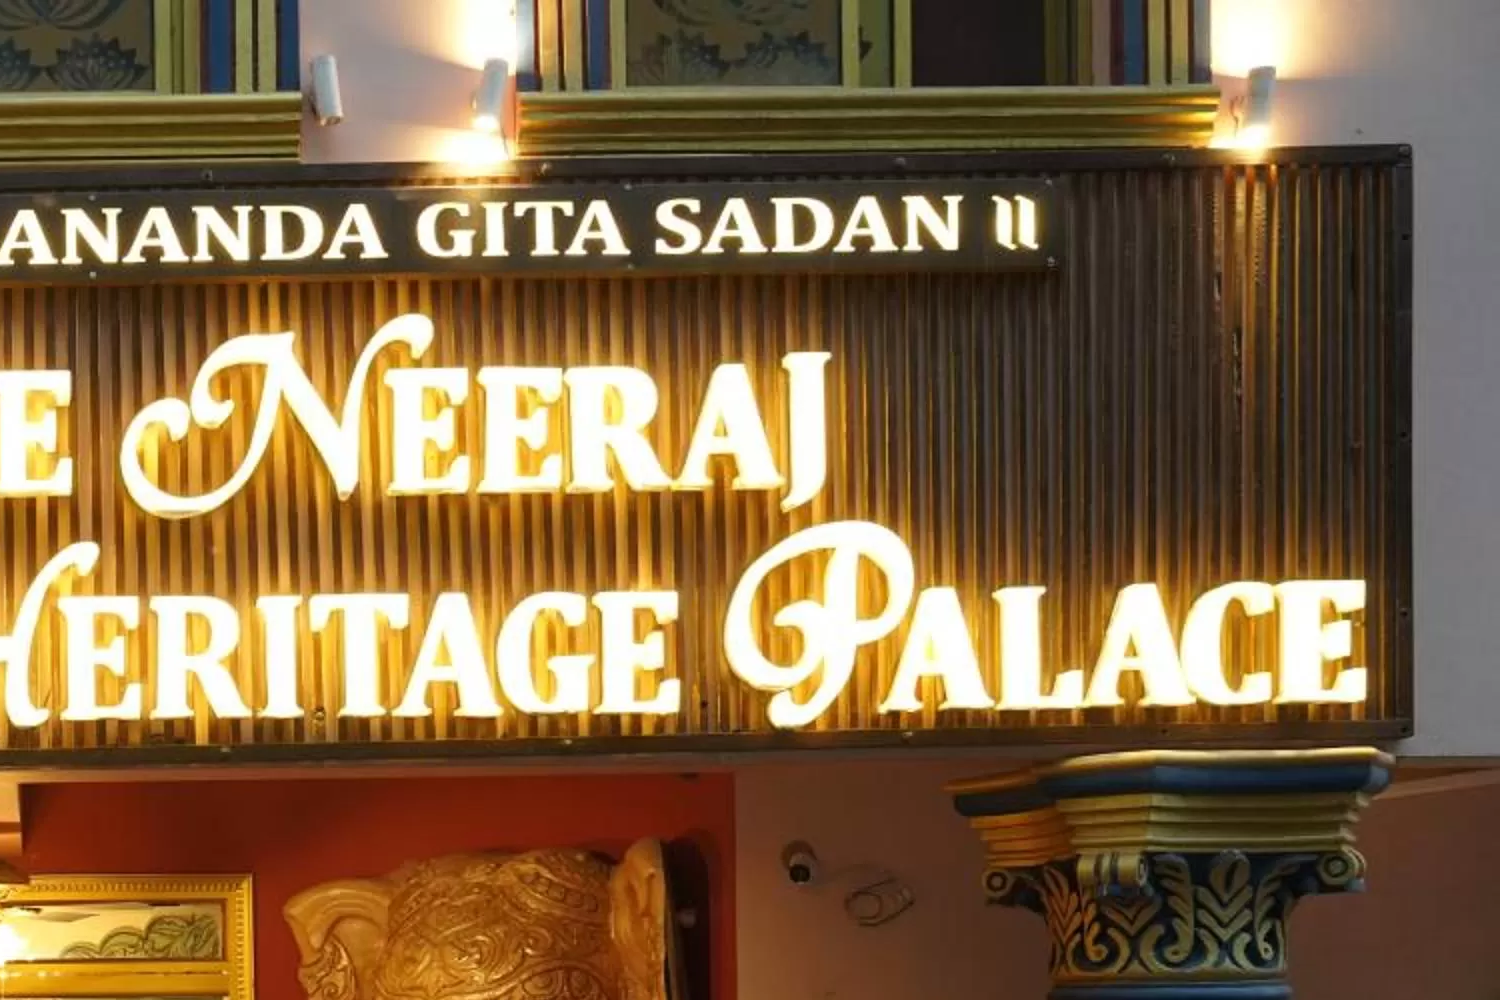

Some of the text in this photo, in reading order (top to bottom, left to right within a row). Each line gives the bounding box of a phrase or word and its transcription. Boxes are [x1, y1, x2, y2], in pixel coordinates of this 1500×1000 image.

[416, 200, 630, 259] GITA
[654, 194, 963, 256] SADAN
[121, 313, 833, 519] NEERAJ
[723, 519, 1368, 729] PALACE
